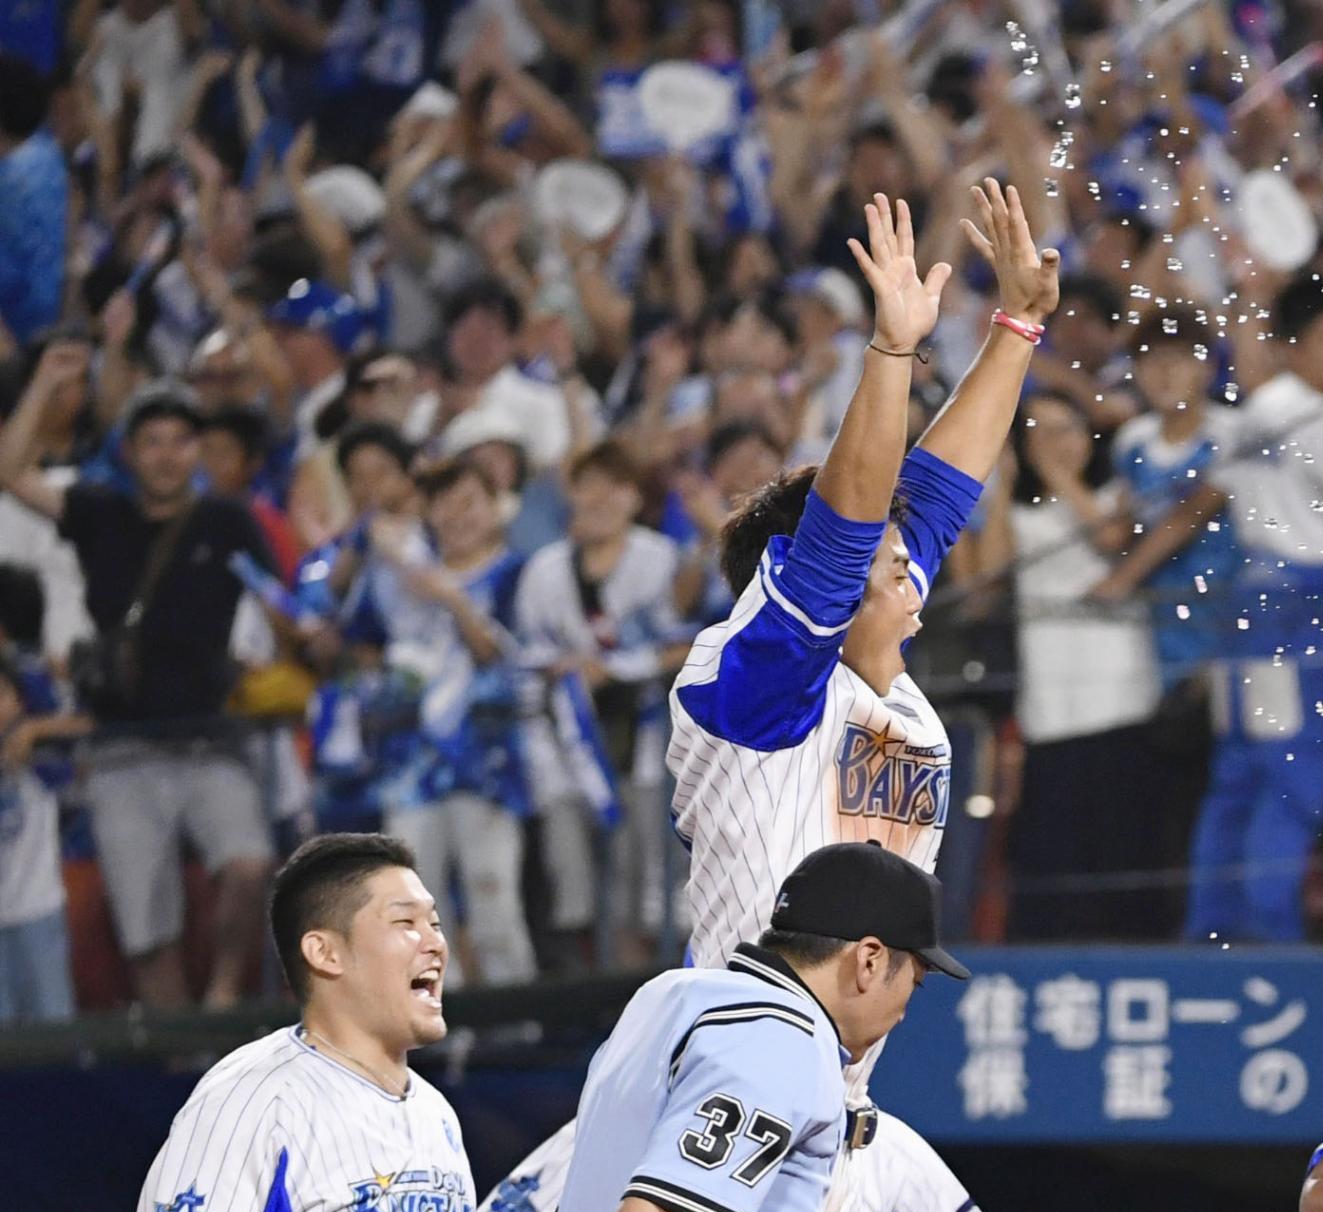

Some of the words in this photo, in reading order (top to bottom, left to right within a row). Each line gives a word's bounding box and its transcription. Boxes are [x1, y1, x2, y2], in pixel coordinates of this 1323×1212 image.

[957, 973, 1307, 1051] 住宅ローン
[678, 1093, 793, 1189] 37
